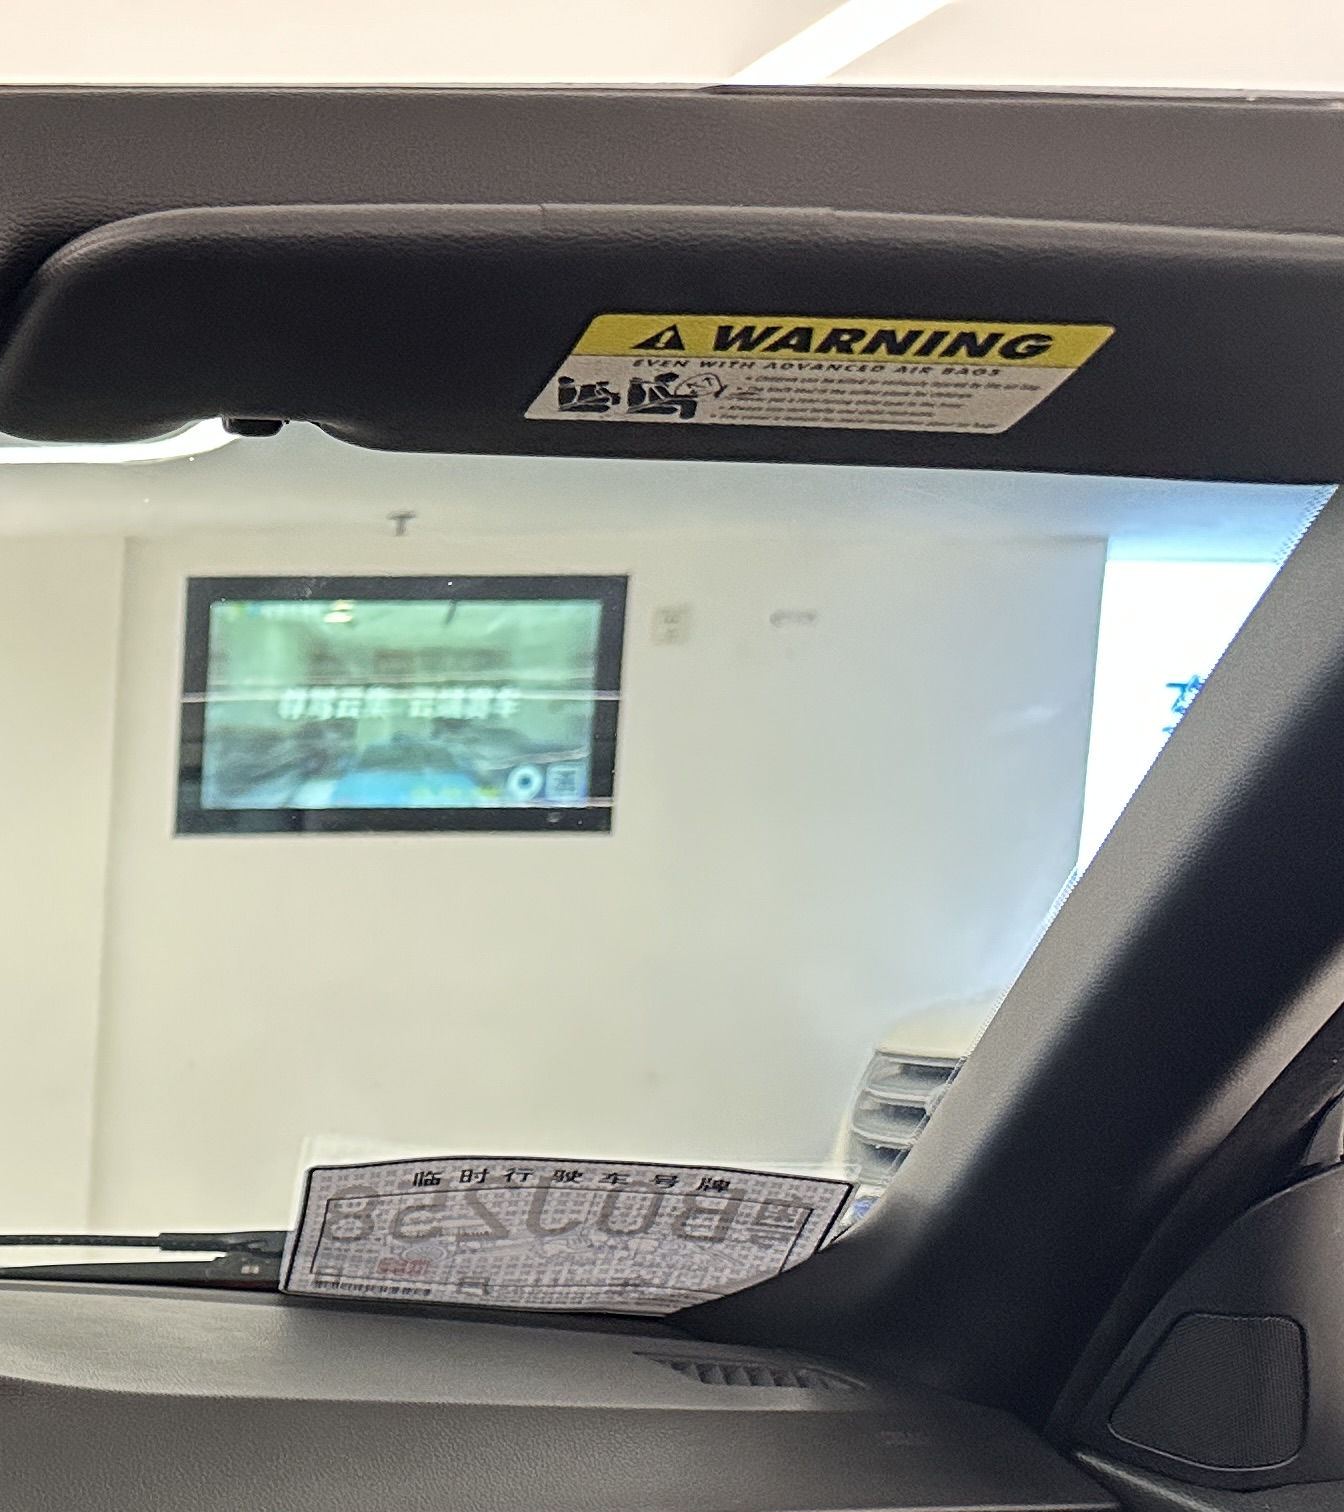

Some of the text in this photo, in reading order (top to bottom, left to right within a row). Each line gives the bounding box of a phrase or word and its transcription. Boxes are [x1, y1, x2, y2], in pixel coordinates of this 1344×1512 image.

[712, 325, 1054, 360] WARNING
[699, 360, 756, 369] WITH
[761, 361, 885, 373] ADVANCED
[893, 364, 934, 375] AIR
[412, 1168, 731, 1193] 临时行驶车号牌
